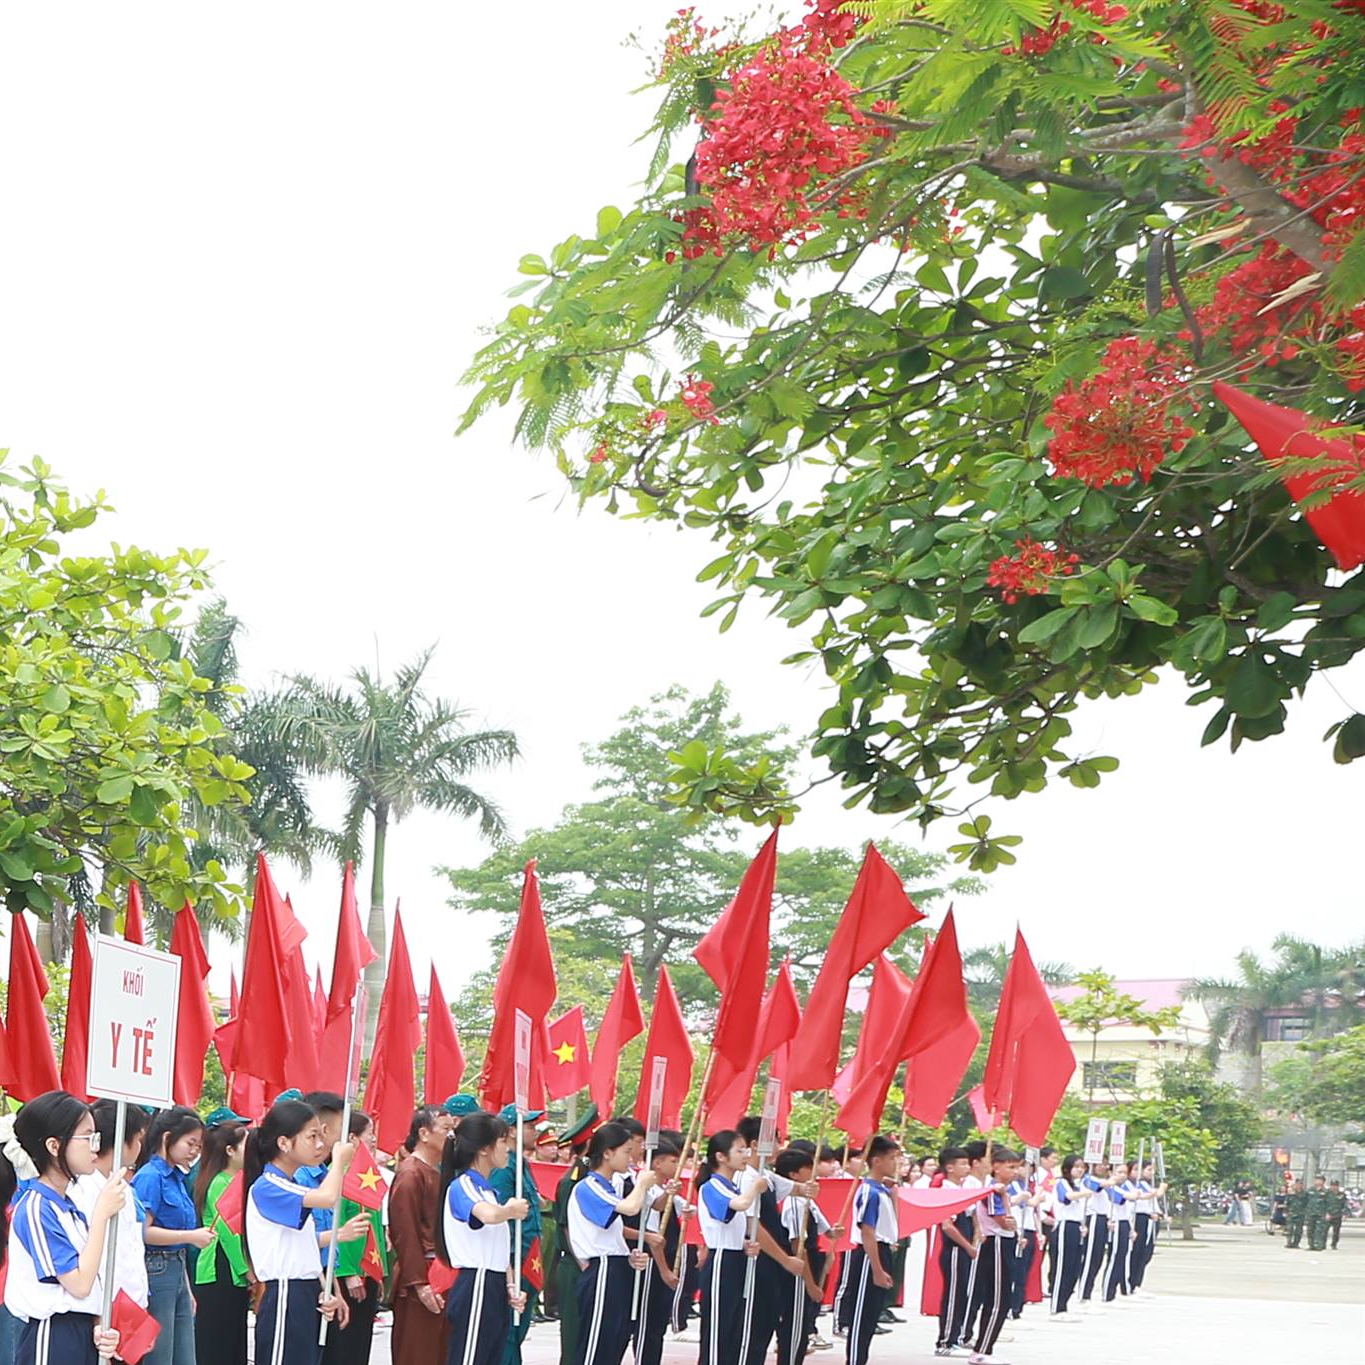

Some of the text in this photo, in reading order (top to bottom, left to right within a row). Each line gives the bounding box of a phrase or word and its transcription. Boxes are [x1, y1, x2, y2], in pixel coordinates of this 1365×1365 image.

[122, 966, 144, 997] KHỐI
[111, 1017, 157, 1076] Y TẾ
